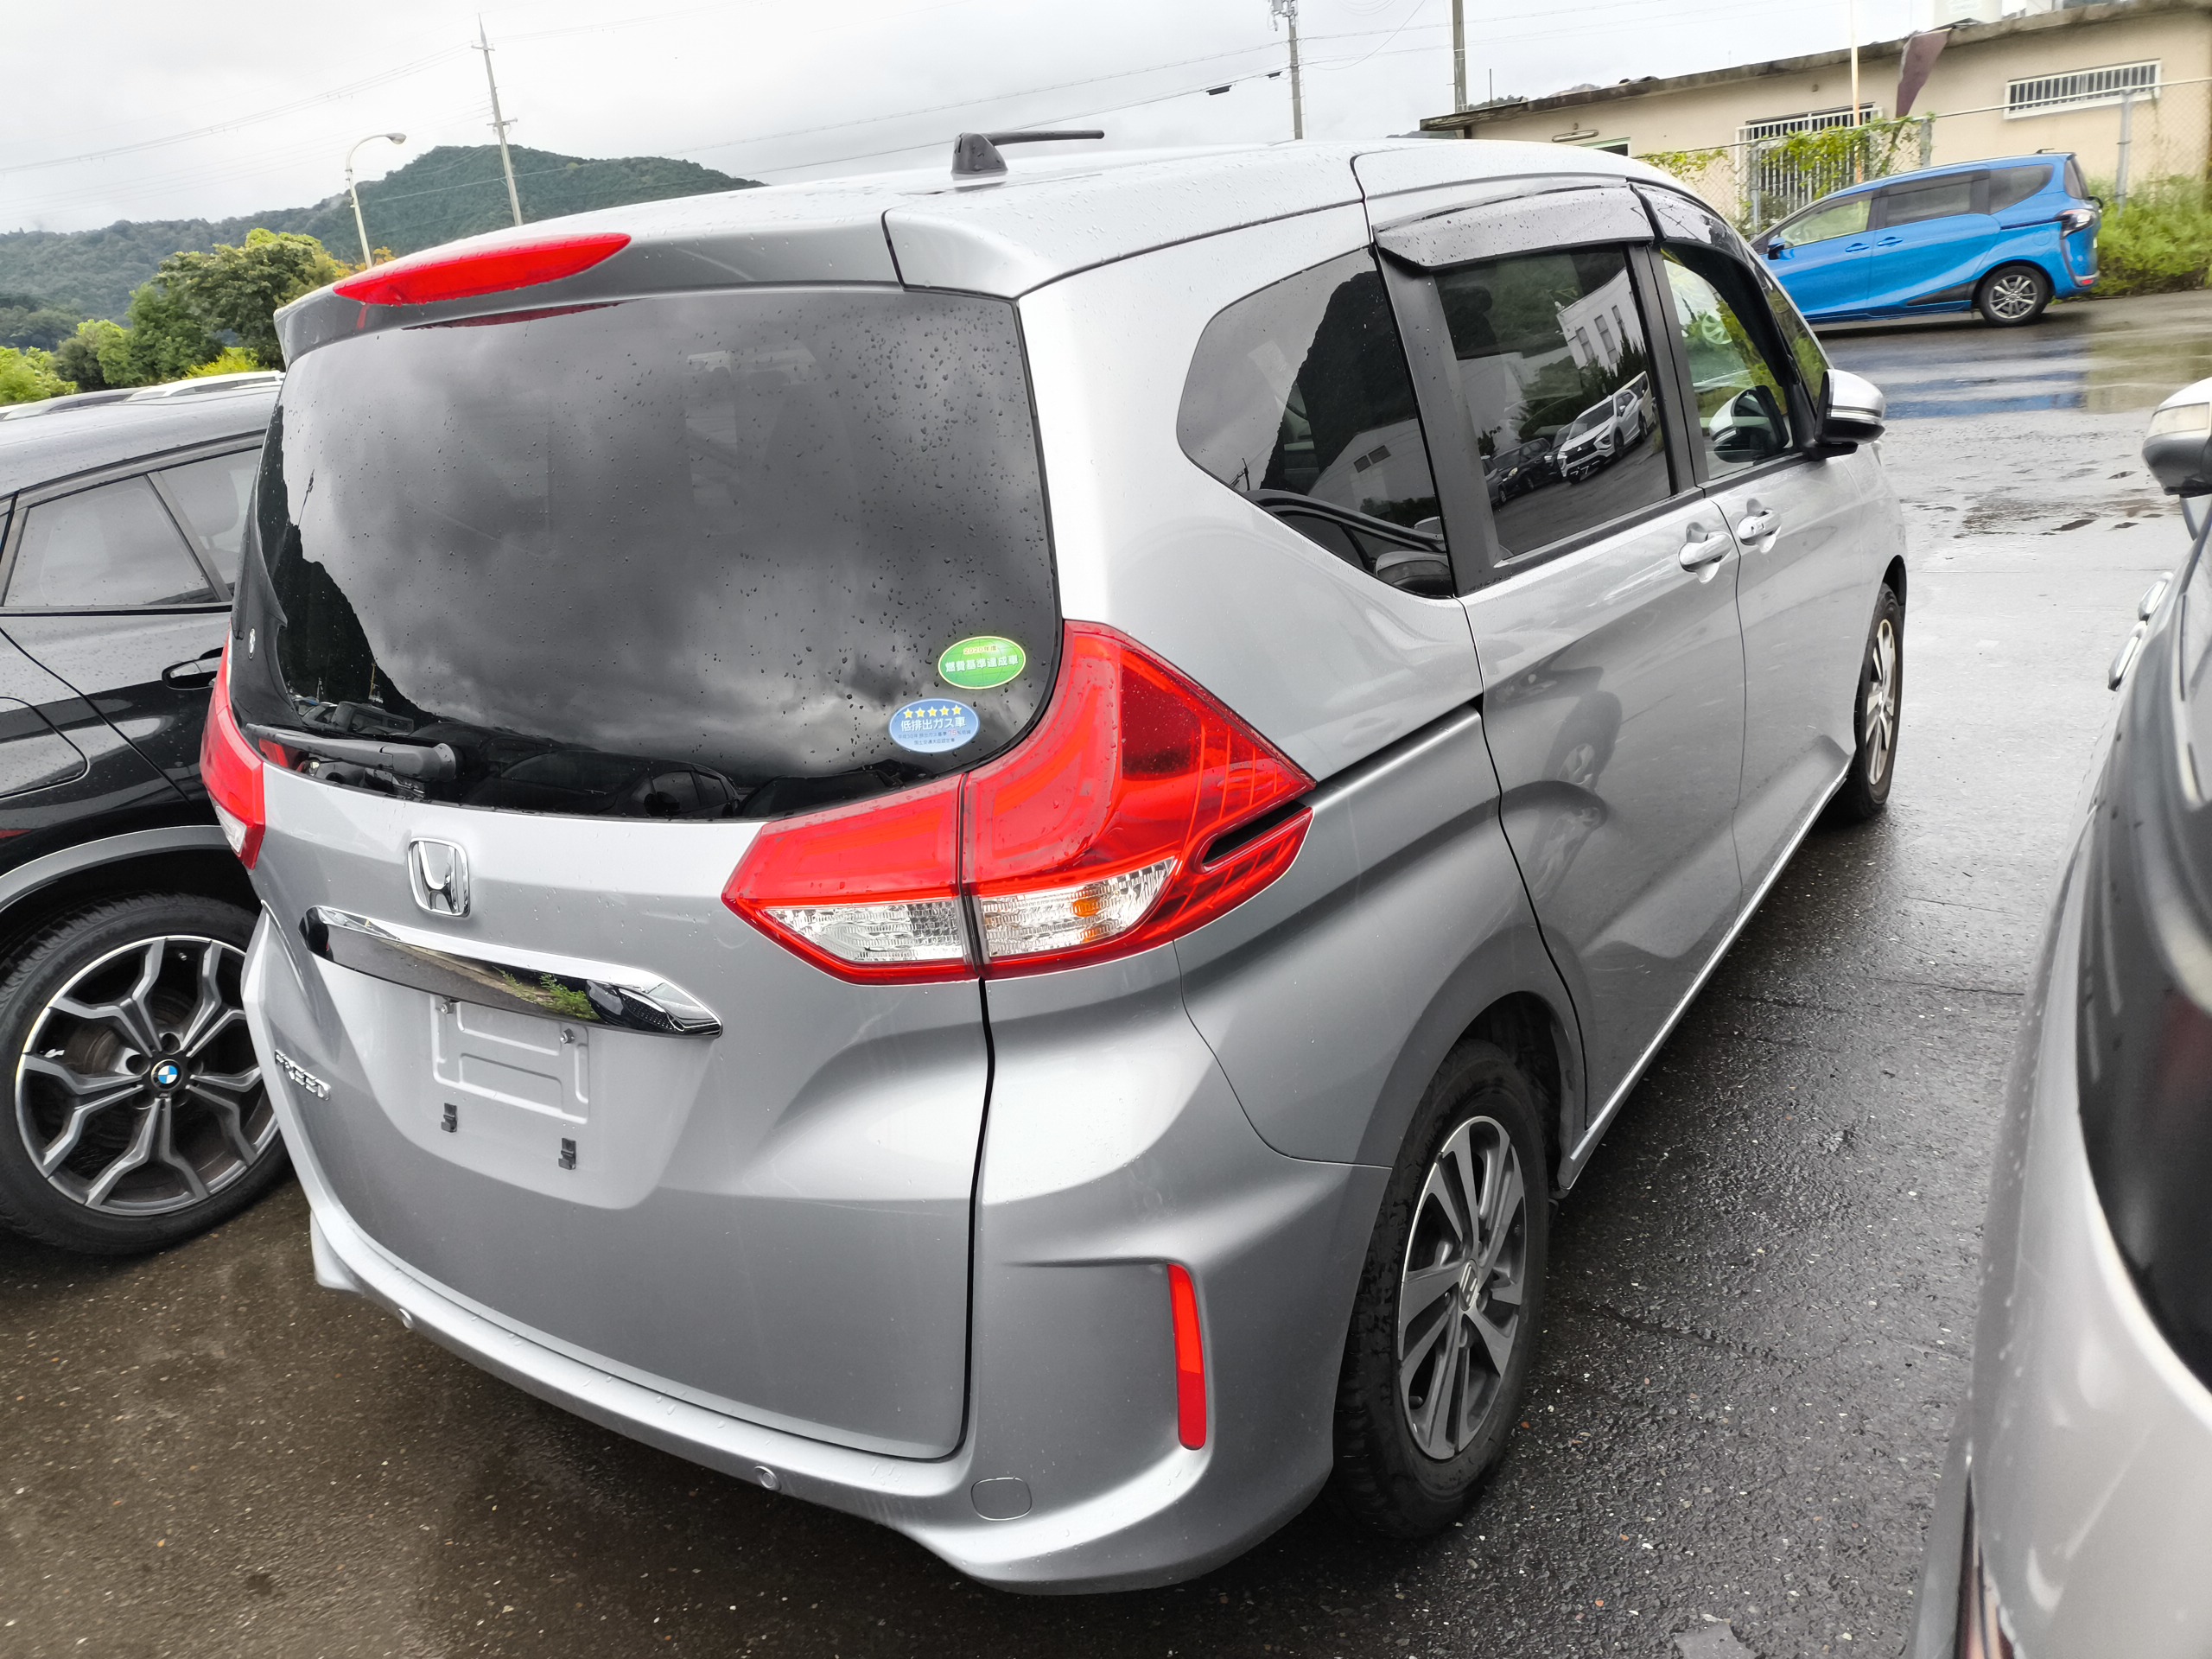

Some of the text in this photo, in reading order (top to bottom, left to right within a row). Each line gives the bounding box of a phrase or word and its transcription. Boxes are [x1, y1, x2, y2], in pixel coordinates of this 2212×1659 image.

[945, 655, 1018, 672] 燃費基準達成車
[901, 716, 965, 732] 低排出ガス車
